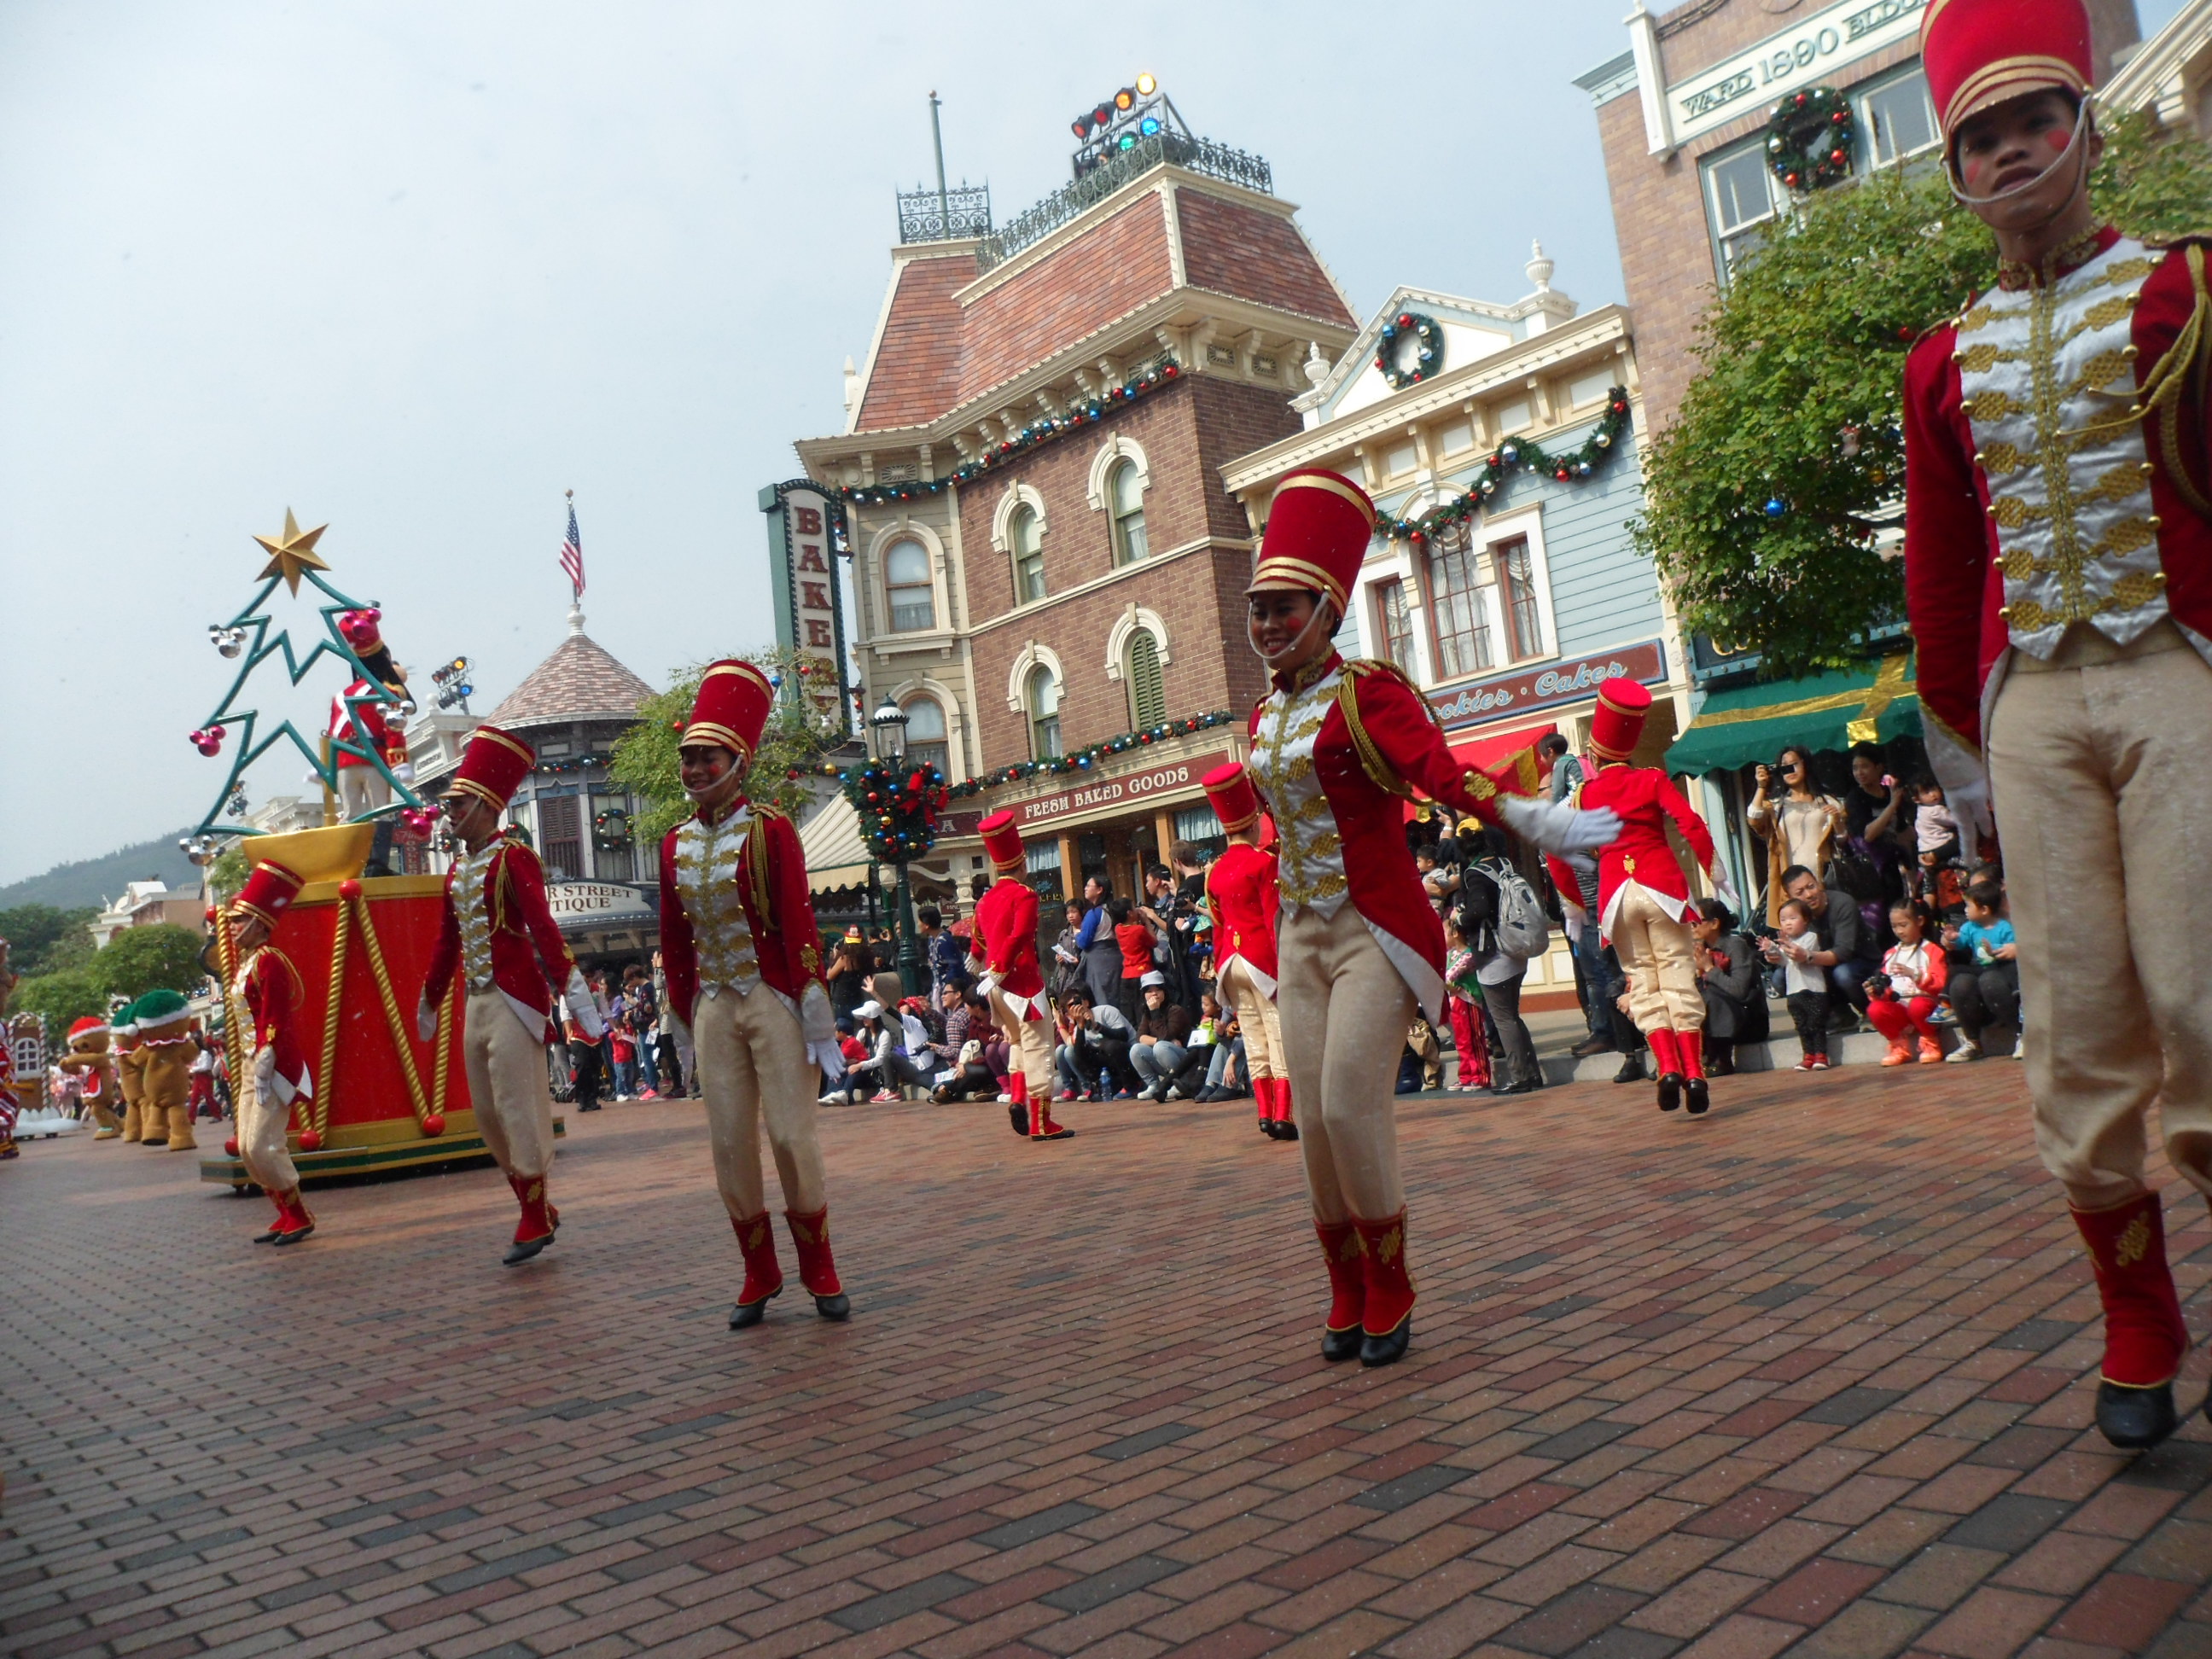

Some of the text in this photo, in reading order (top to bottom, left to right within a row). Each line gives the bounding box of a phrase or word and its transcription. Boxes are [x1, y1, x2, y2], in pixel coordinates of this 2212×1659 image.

[1685, 71, 1754, 117] WARD
[1758, 27, 1839, 84] 1890
[1534, 661, 1627, 696] Cakes
[1025, 766, 1189, 818] FRESH BAKED GOODS
[552, 898, 611, 912] TIQUE
[564, 885, 633, 898] STREET
